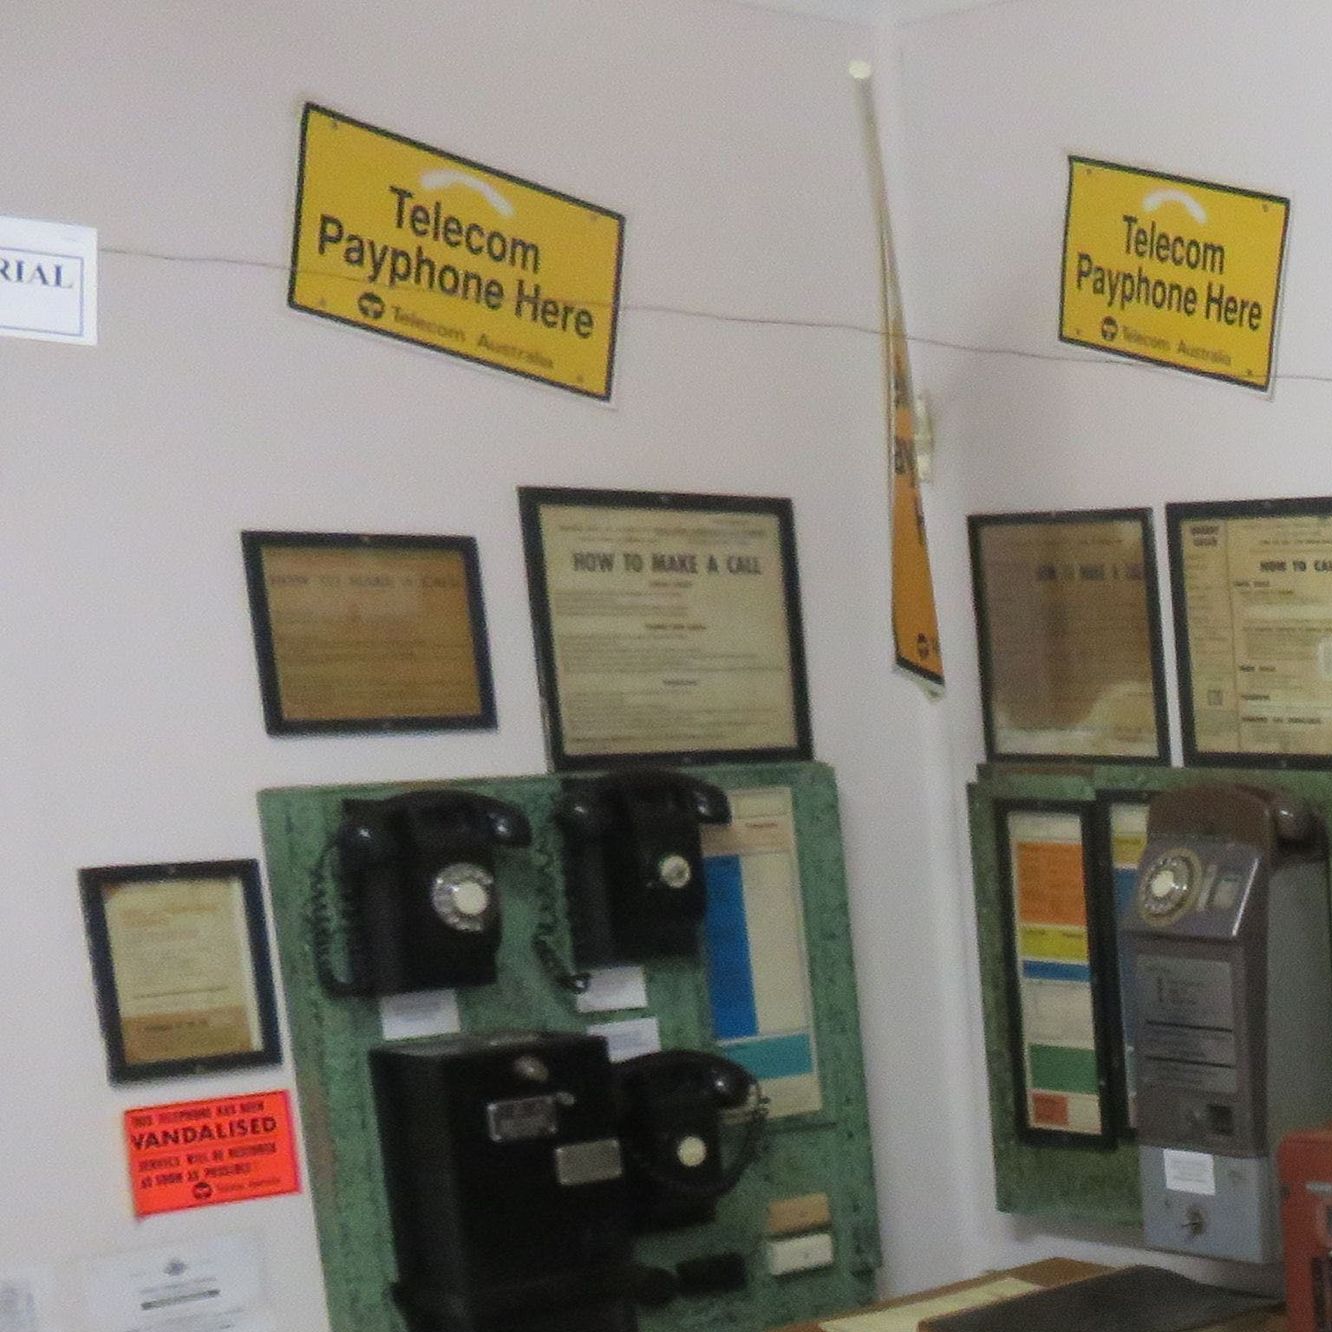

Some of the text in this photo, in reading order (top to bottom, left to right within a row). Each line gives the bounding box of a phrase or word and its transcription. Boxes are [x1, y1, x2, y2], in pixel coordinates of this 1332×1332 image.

[389, 185, 541, 274] Telecom
[1122, 215, 1225, 275] Telecom
[318, 214, 594, 339] Payphone Here
[1076, 251, 1262, 331] Payphone Here
[573, 552, 762, 575] HOW TO MAKE A CALL
[1293, 559, 1307, 572] TO
[131, 1116, 278, 1150] VANDALISED
